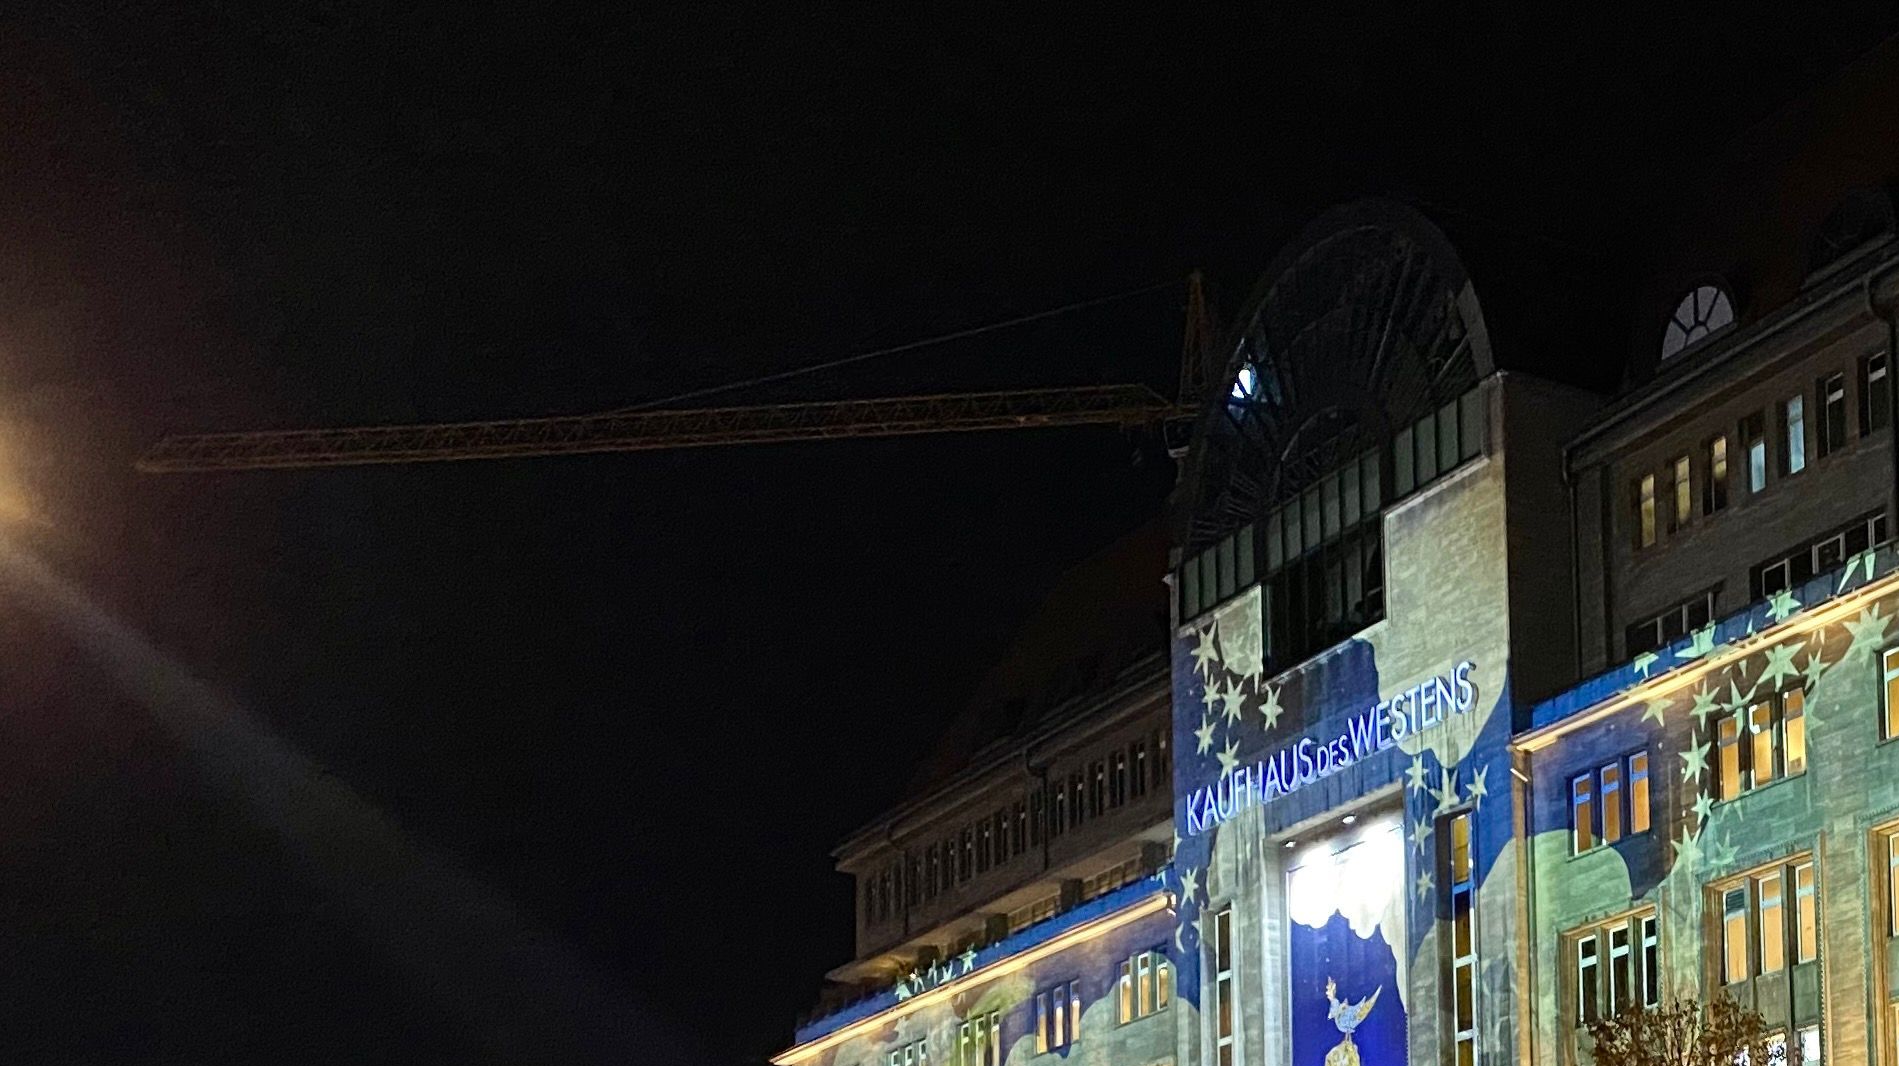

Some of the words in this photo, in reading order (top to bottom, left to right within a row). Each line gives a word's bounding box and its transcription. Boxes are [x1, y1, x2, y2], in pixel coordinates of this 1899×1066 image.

[1186, 737, 1317, 837] KAUFHAUS
[1316, 734, 1353, 778] DES
[1348, 660, 1479, 761] WESTENS
